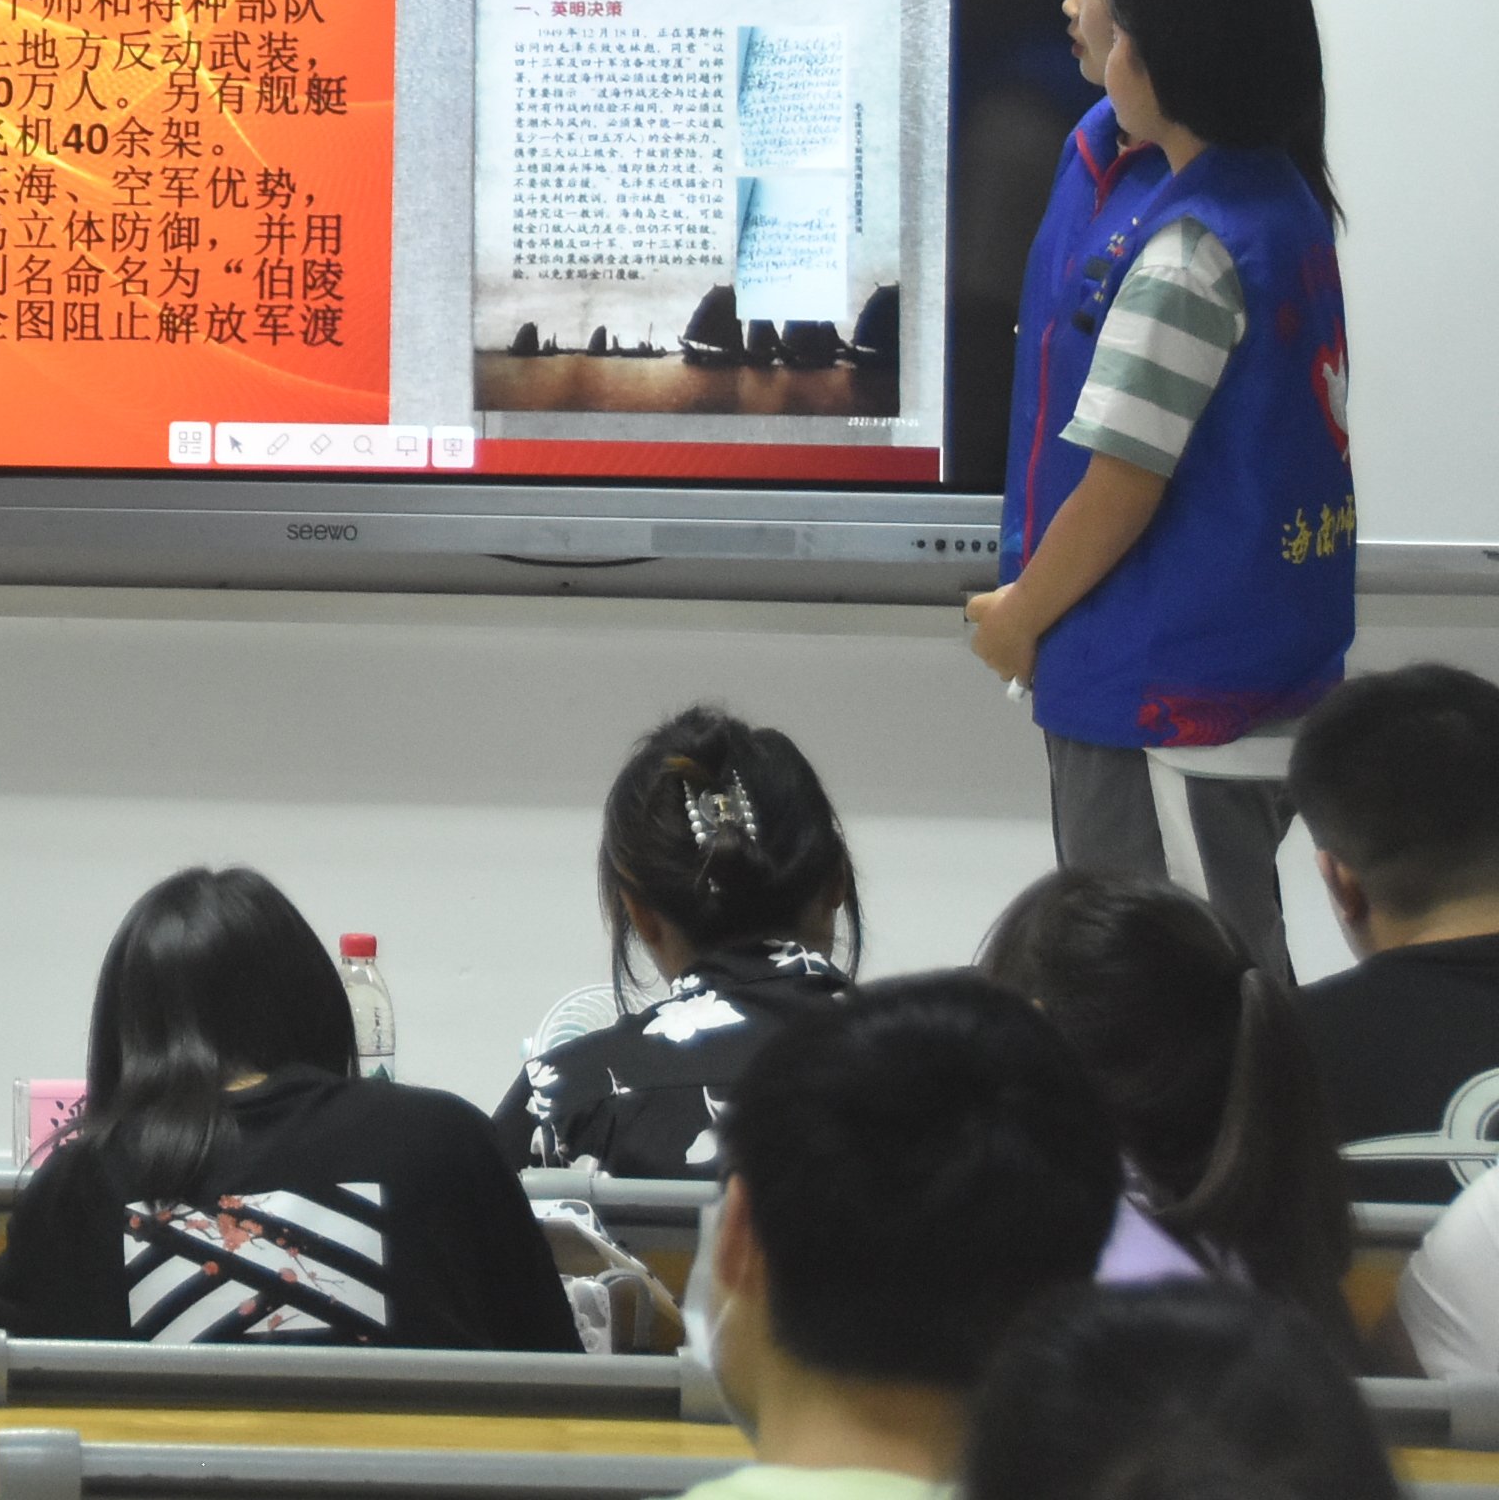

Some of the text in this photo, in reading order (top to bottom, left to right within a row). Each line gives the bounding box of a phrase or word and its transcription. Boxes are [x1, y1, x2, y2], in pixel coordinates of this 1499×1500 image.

[515, 1, 622, 17] 一、英明决策
[287, 523, 358, 541] seewo
